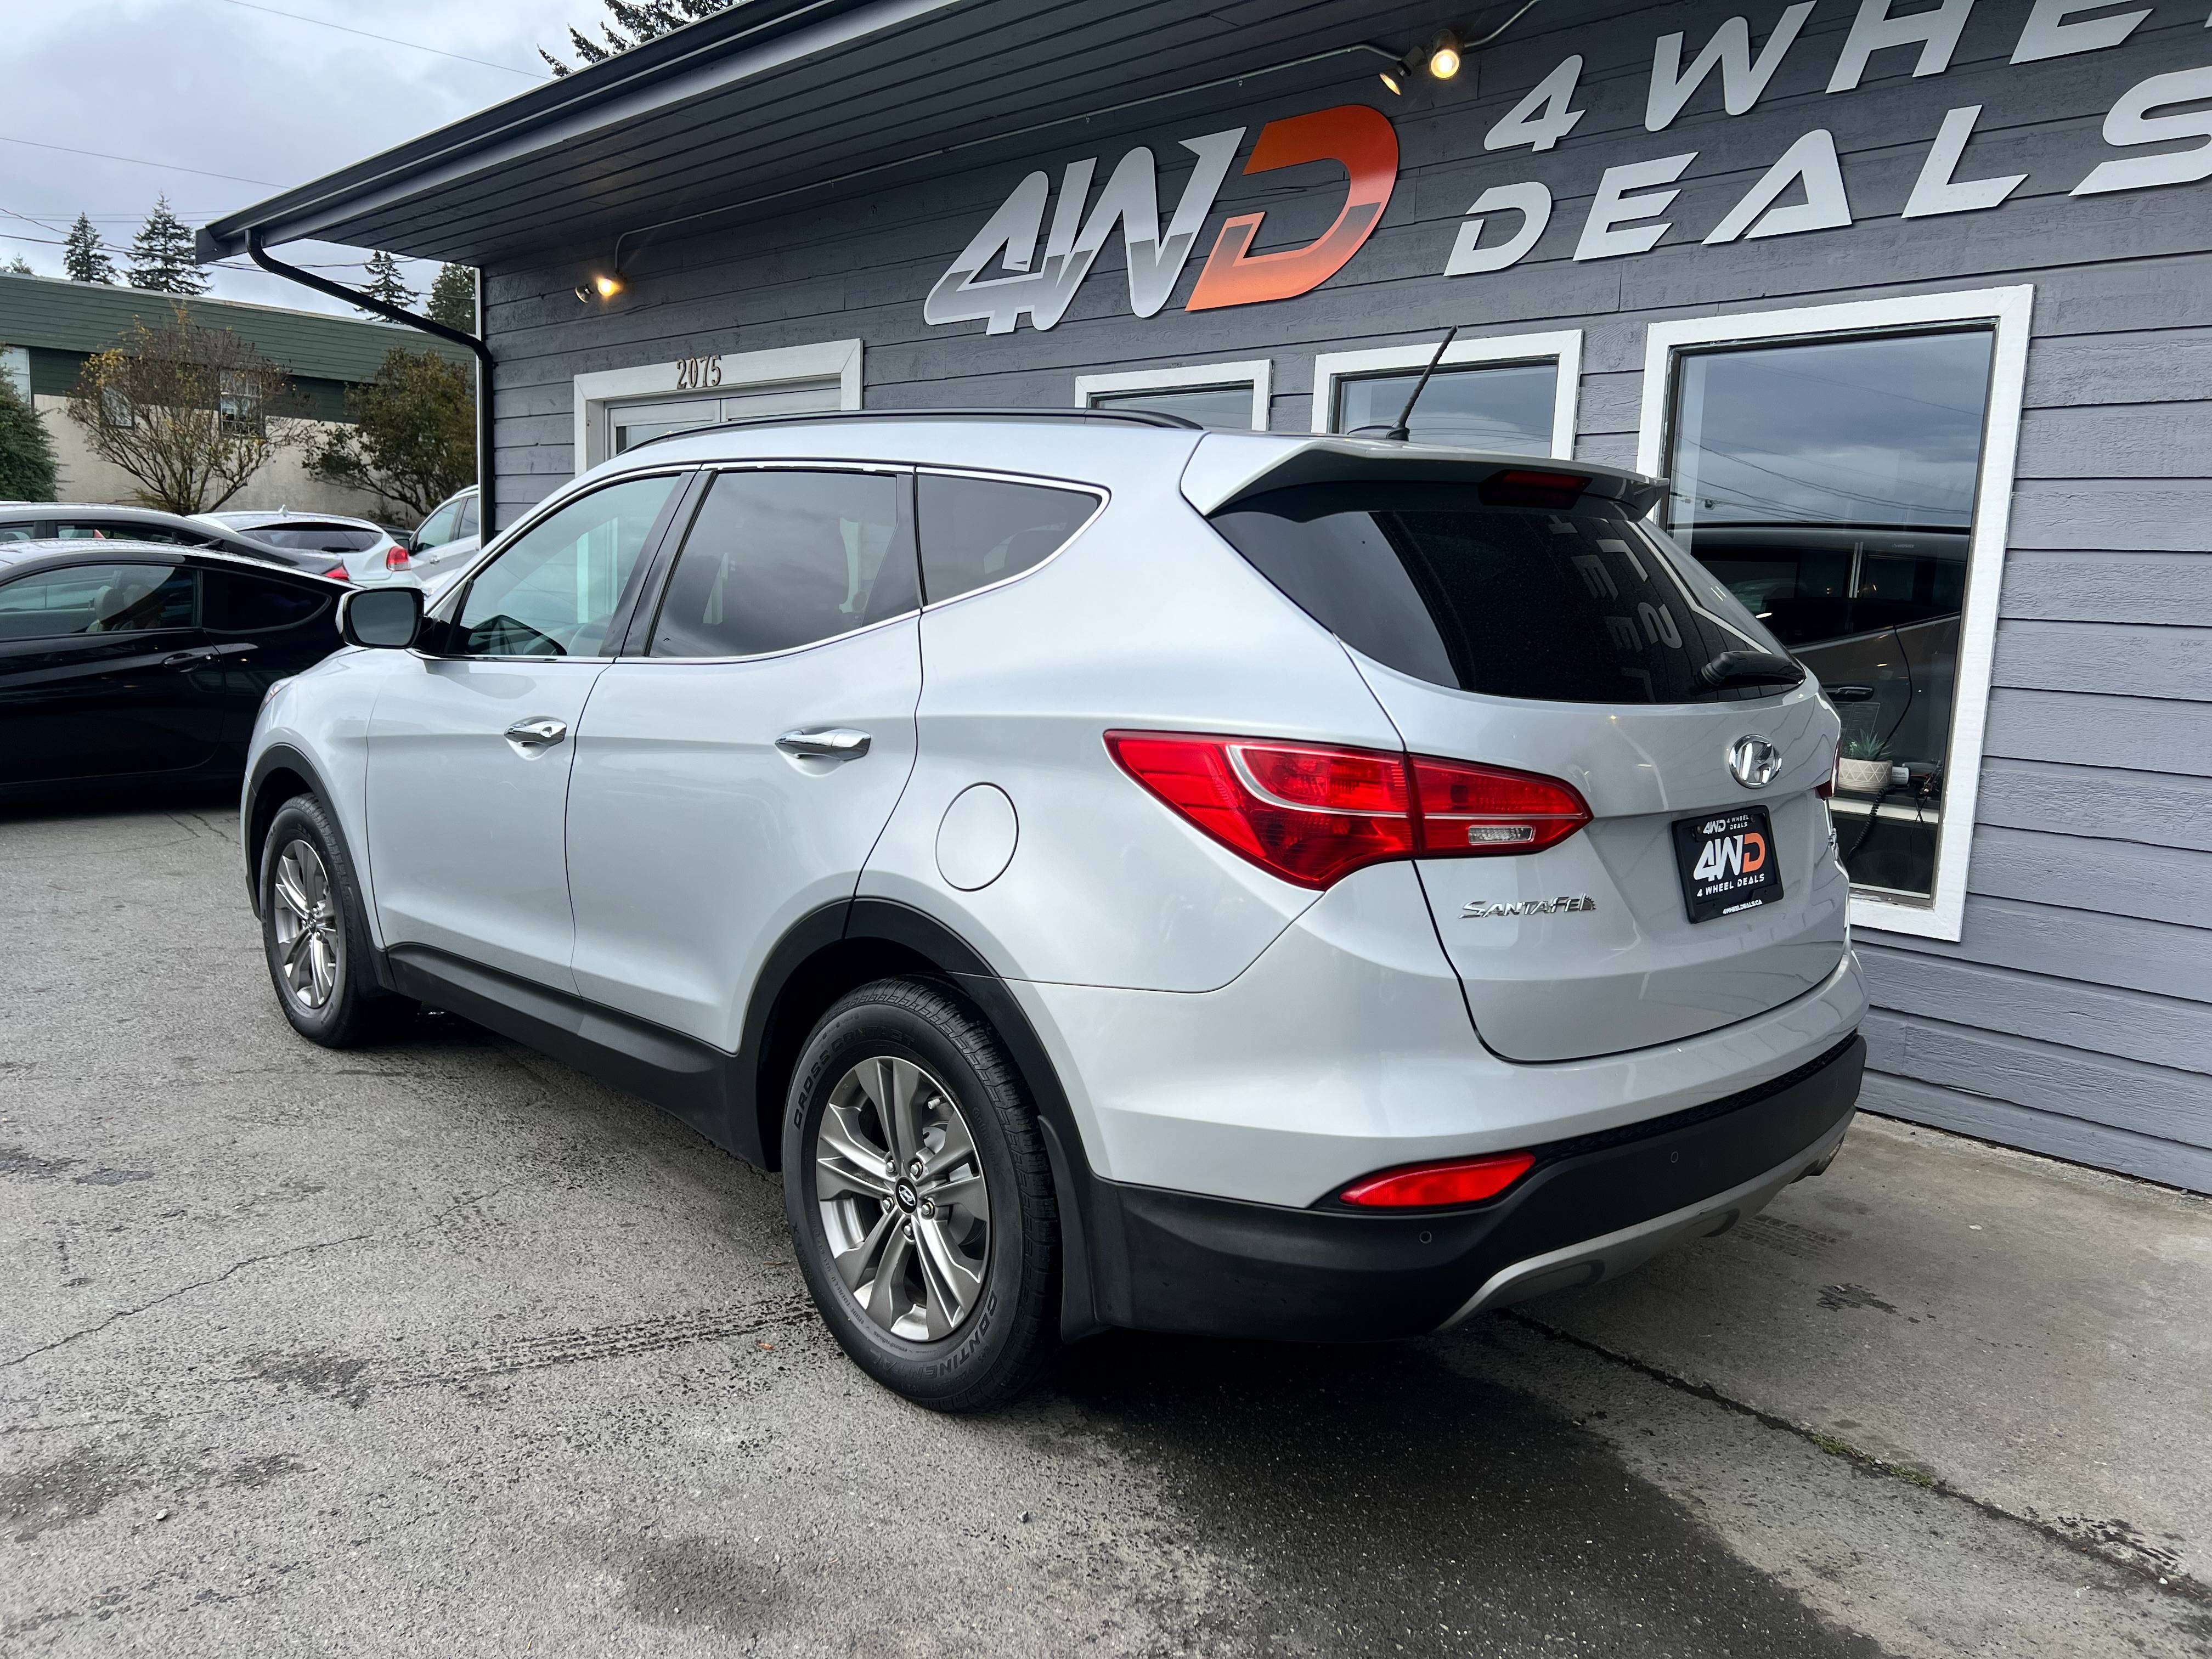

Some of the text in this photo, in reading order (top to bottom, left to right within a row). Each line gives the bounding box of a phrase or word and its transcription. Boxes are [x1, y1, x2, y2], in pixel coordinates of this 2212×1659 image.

[1483, 53, 1587, 152] 4
[1443, 66, 2212, 276] DEALS
[924, 104, 1399, 335] 4WD
[676, 354, 722, 390] 2075
[1703, 819, 1726, 834] 4WD
[1730, 821, 1748, 830] DEALS
[1693, 832, 1765, 882] 4WD
[1697, 873, 1765, 897] 4 WHEEL DEALS
[870, 1290, 998, 1379] CONTINENTAL
